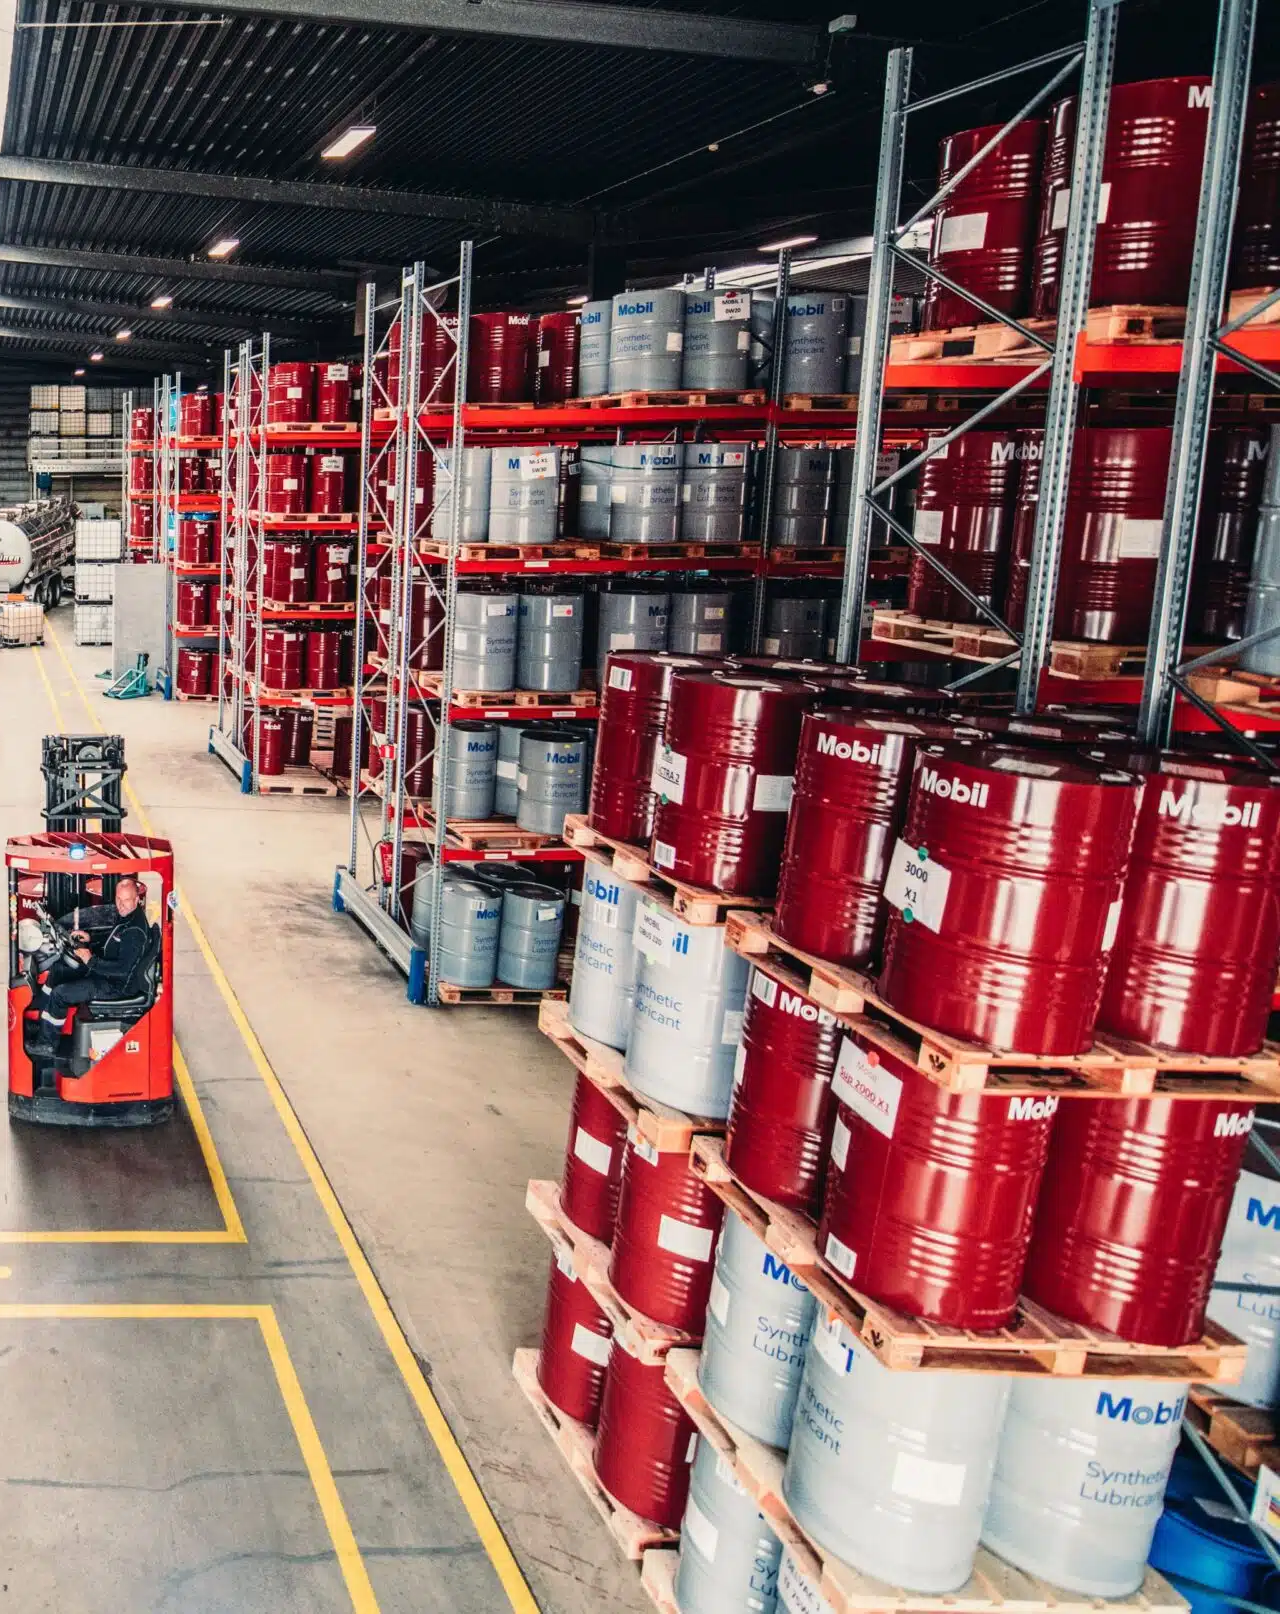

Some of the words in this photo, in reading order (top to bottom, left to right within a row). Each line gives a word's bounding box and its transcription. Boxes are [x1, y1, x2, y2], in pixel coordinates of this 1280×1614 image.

[581, 312, 601, 324] obil
[618, 302, 653, 316] Mobil
[686, 301, 711, 314] obil
[788, 304, 825, 316] Mobil
[437, 316, 459, 326] Mob
[616, 333, 652, 344] Synthetic
[789, 346, 825, 354] ubricant
[790, 336, 825, 345] ynthetic
[641, 486, 675, 494] Snthetic
[698, 486, 736, 494] Synhetic
[547, 752, 580, 764] Mobil
[817, 732, 888, 765] Mobil
[920, 767, 989, 808] Mobil
[1158, 790, 1261, 828] Mobil
[905, 861, 928, 883] 3000
[904, 887, 917, 903] X1
[477, 910, 499, 920] Mob
[644, 914, 661, 931] MOBIL
[578, 950, 613, 974] bricant
[637, 982, 683, 1012] nthetic
[635, 1000, 682, 1030] bricant
[854, 1079, 876, 1102] 2000
[877, 1096, 890, 1114] X1
[1214, 1110, 1255, 1137] Mob
[756, 1316, 808, 1348] Synth
[752, 1336, 805, 1368] Lubri
[807, 1385, 844, 1433] thetic
[1096, 1390, 1185, 1425] Mobil
[801, 1407, 842, 1455] ricant
[1086, 1461, 1165, 1485] Synthet
[1080, 1482, 1161, 1507] Lubrica
